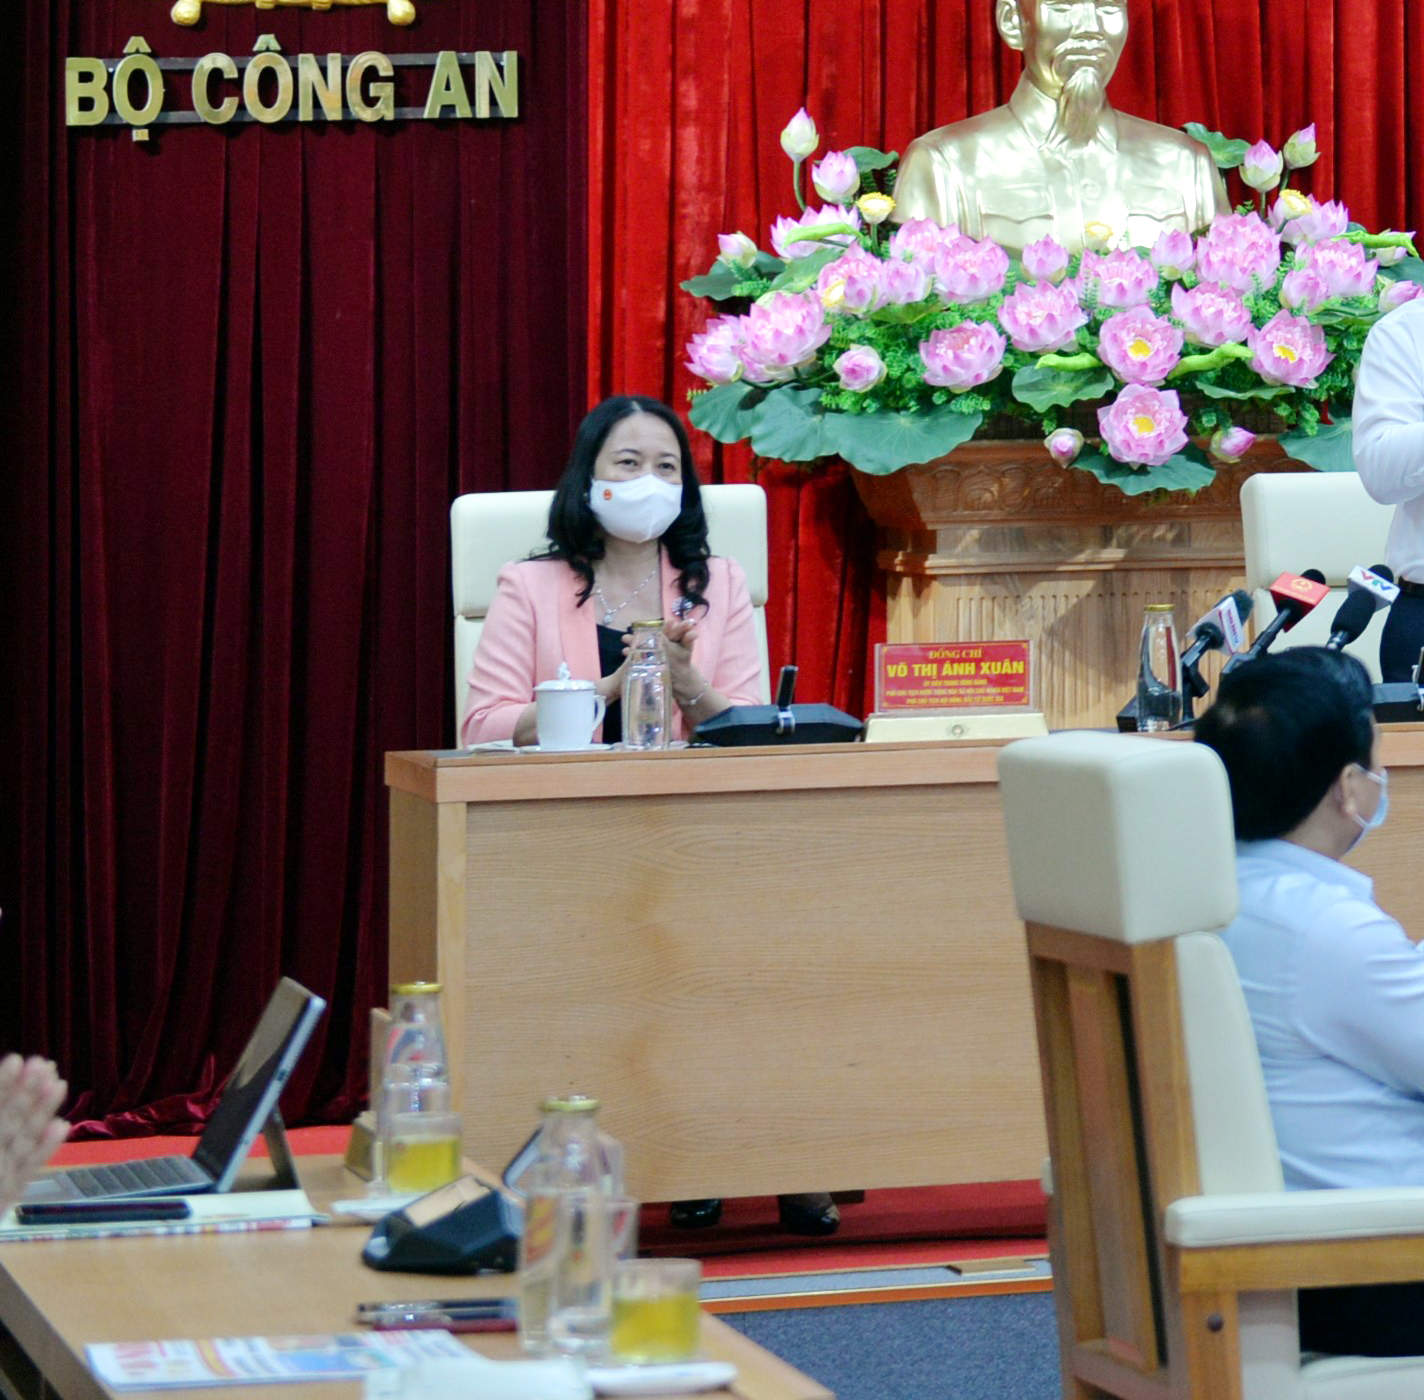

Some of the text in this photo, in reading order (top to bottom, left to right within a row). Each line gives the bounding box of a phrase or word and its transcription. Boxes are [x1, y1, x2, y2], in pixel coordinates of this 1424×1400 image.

[65, 33, 519, 142] BỘ CÔNG AN
[887, 659, 1024, 679] VÕ THỊ ÁNH XUÂN
